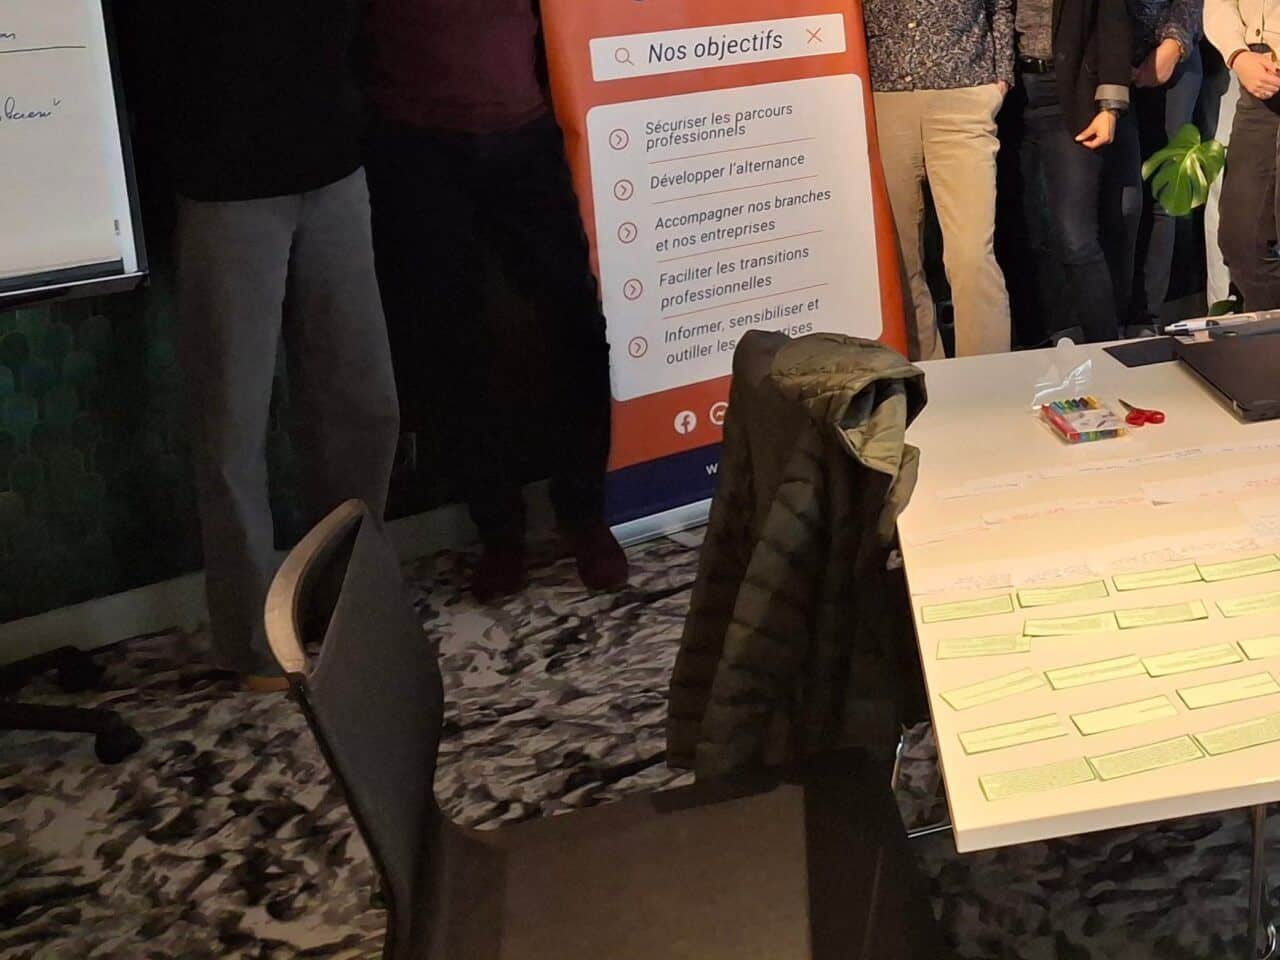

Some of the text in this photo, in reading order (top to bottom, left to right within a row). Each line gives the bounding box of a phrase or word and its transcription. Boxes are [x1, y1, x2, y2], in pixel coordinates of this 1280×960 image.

[647, 29, 783, 64] Nos objectifs
[645, 103, 793, 136] Sécuriser les parcours
[646, 121, 746, 152] professionnels
[649, 153, 805, 190] Développer l'alternance
[654, 189, 831, 230] Accompagner nos branches
[656, 218, 776, 252] et nos entreprises
[659, 247, 809, 287] Faciliter les transitions
[660, 274, 773, 311] professionnelles
[664, 298, 820, 344] Informer, sensibiliser et
[665, 341, 713, 366] outiller
[716, 338, 736, 354] les
